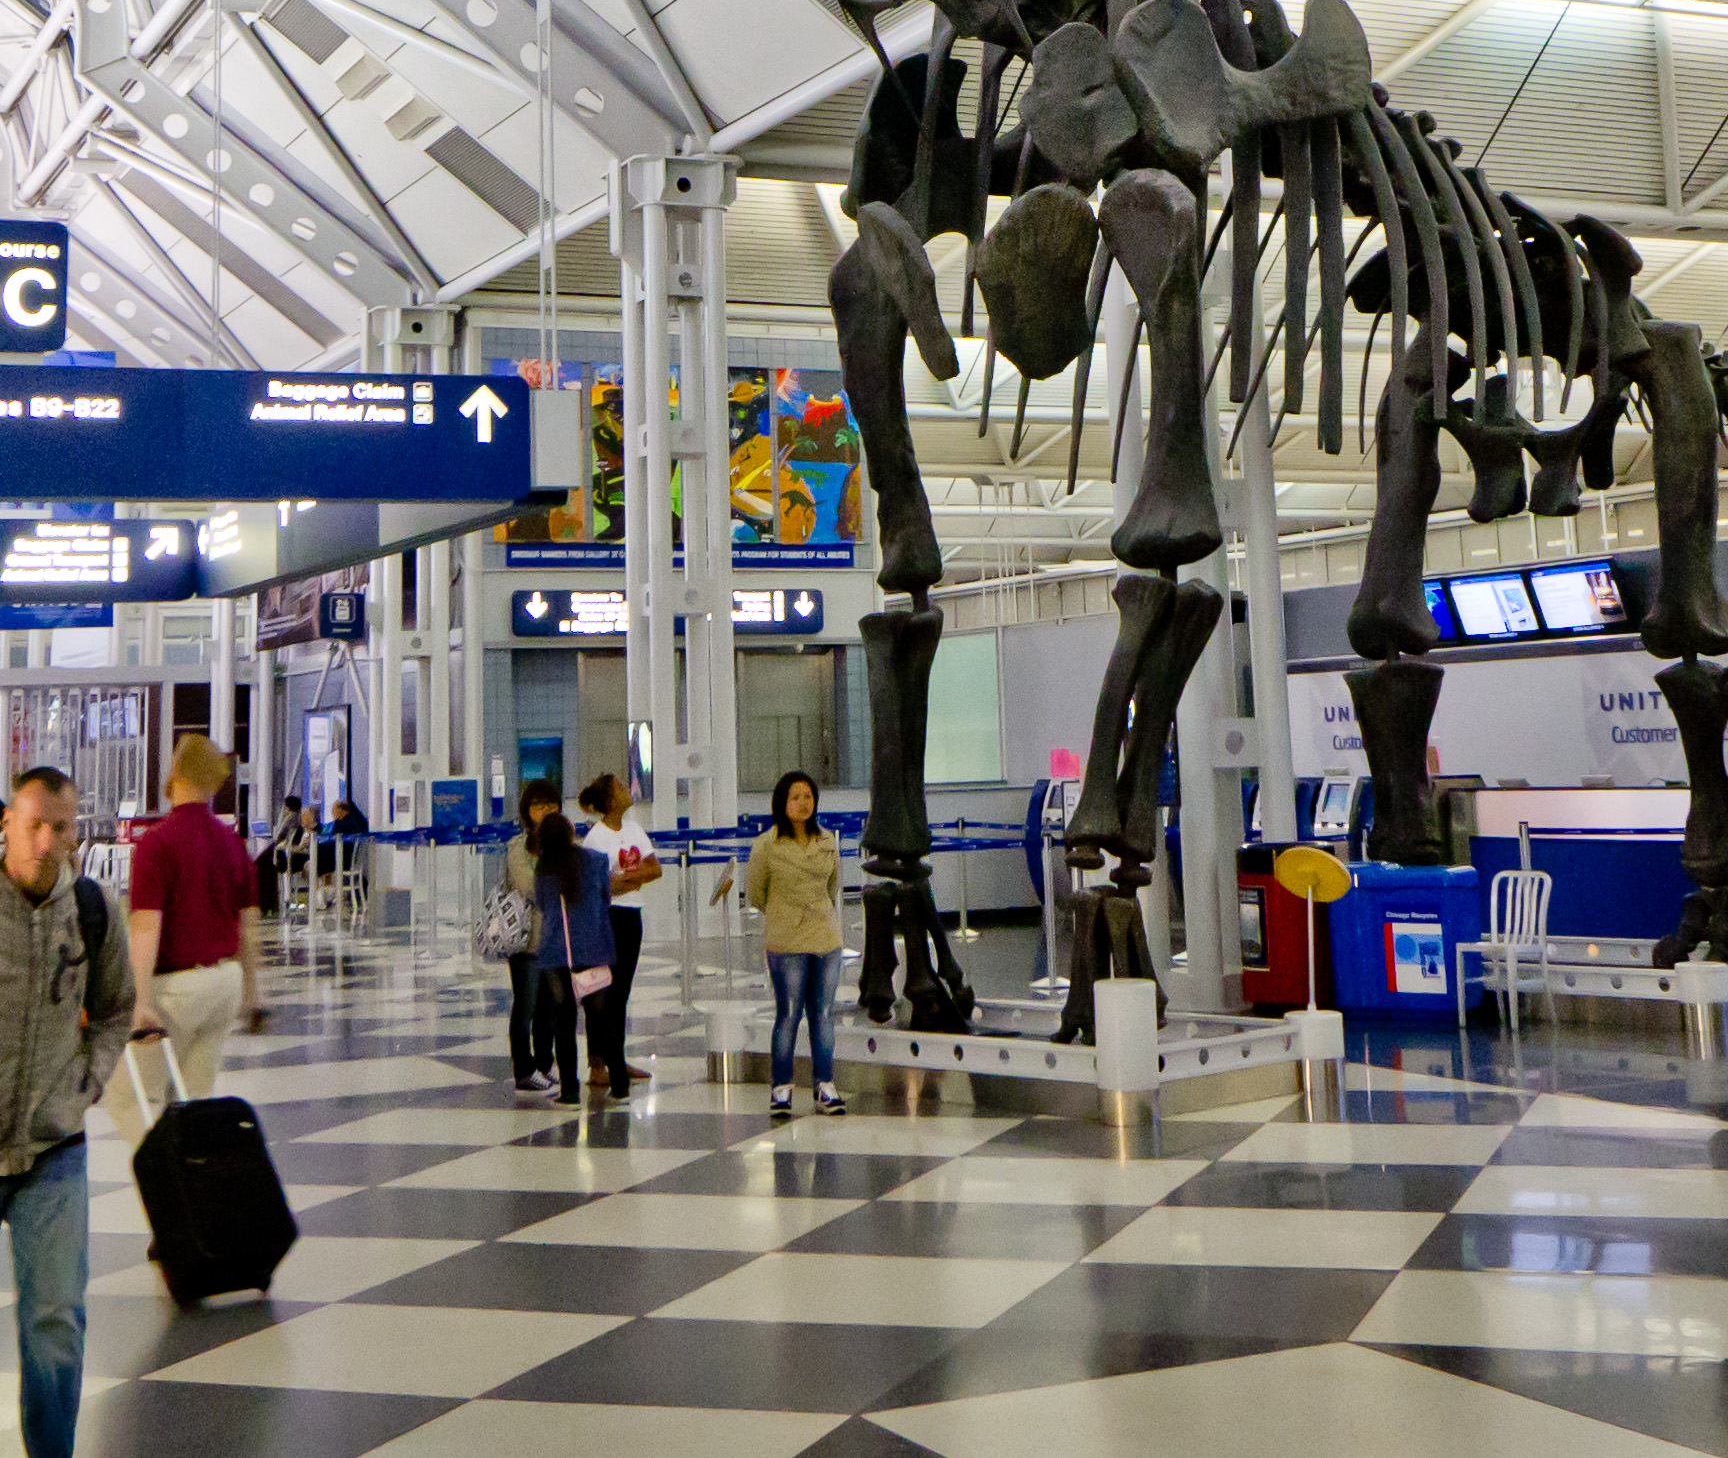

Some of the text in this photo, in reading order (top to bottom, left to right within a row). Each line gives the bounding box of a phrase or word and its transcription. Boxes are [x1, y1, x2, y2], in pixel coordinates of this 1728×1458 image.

[2, 267, 57, 327] C
[267, 379, 405, 402] Baggage Claim
[29, 396, 121, 419] B9-B22
[1611, 725, 1678, 744] Customer
